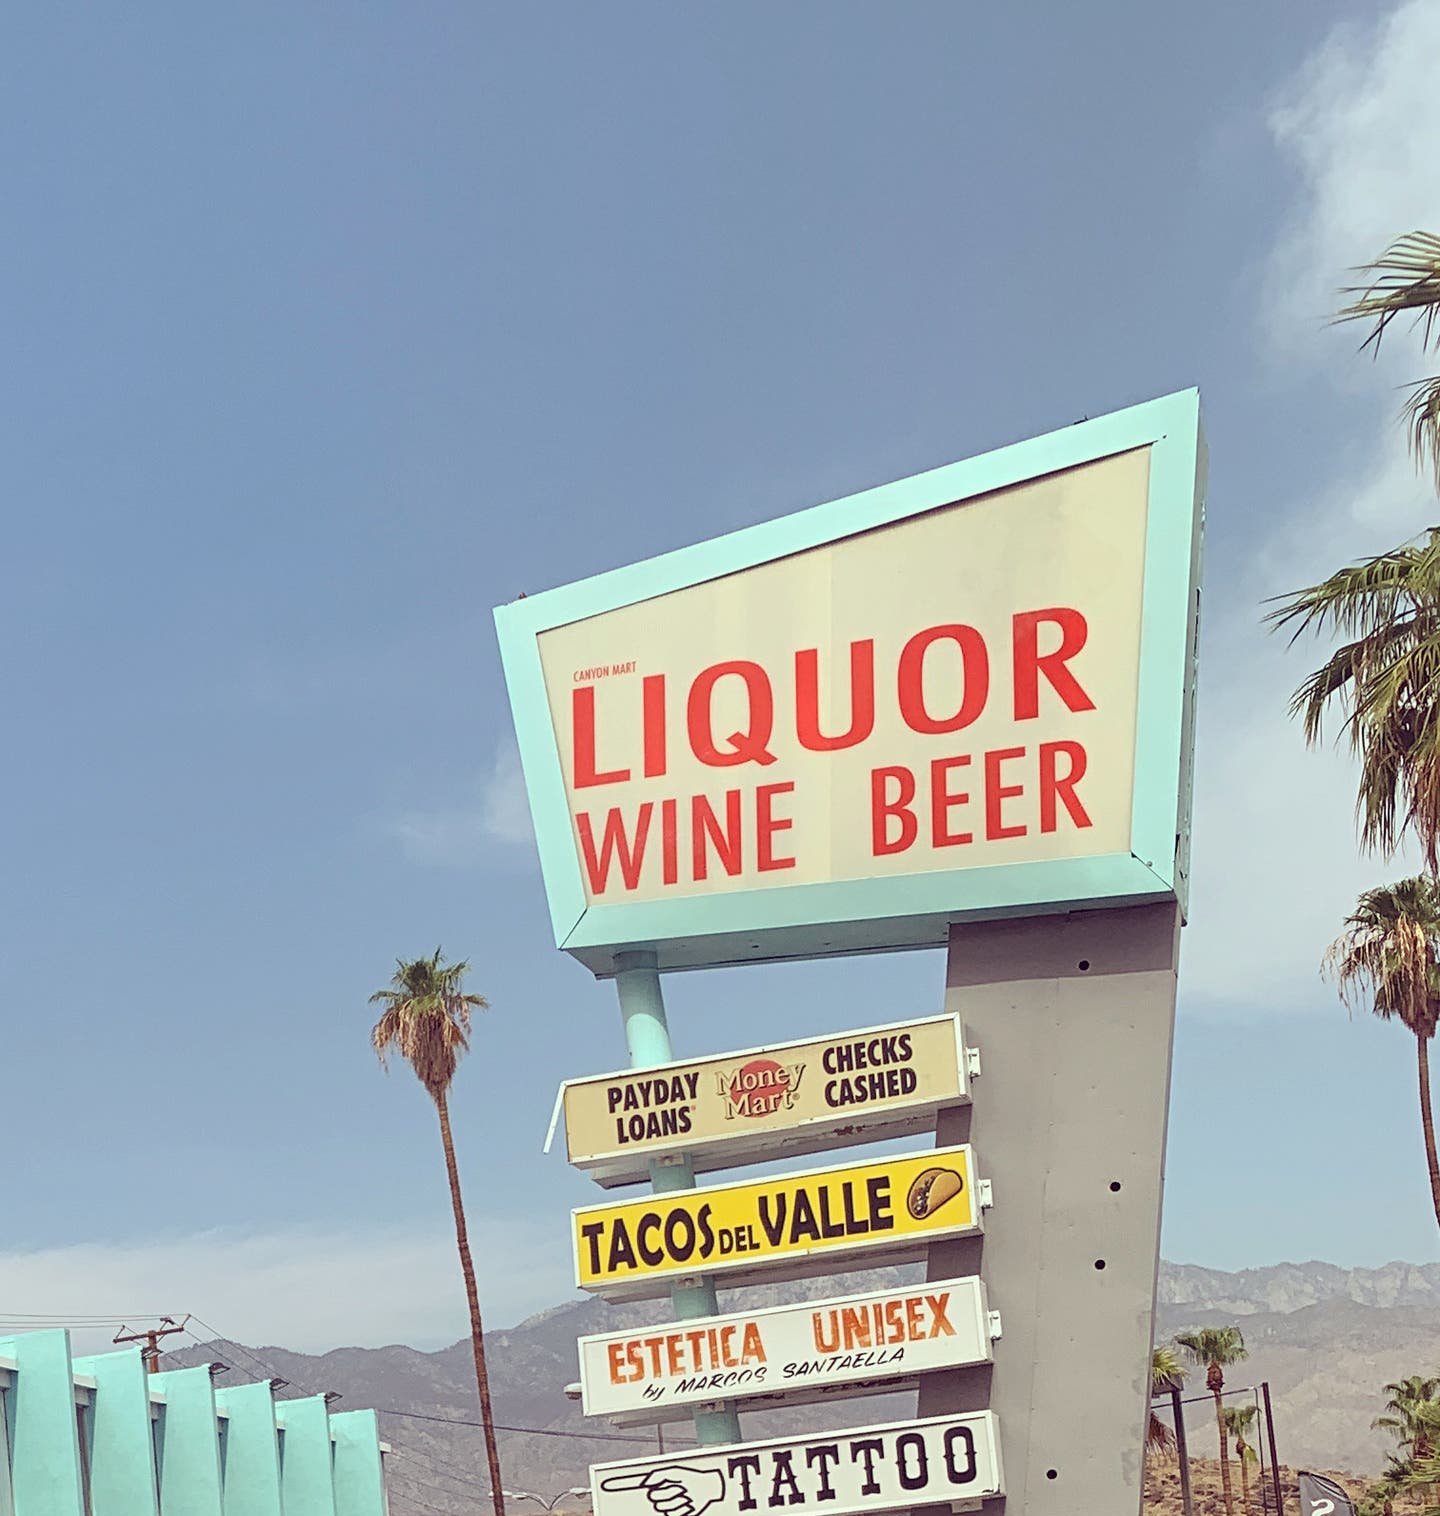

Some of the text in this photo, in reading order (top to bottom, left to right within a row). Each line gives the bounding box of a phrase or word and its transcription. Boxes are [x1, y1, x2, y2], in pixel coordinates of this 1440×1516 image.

[573, 661, 637, 682] CANYON MART
[572, 607, 1097, 790] LIQUOR
[575, 740, 1093, 895] WINE BEER
[714, 1062, 806, 1096] Money
[822, 1034, 913, 1075] CHECKS
[608, 1072, 700, 1114] PAYDAY
[824, 1067, 917, 1108] CASHED
[581, 1175, 895, 1275] TACOS DEL VALLE
[607, 1292, 957, 1385] ESTETICA UNISEX
[642, 1347, 905, 1400] by MARCOS SANTAELLA
[727, 1426, 977, 1512] TATTOO
